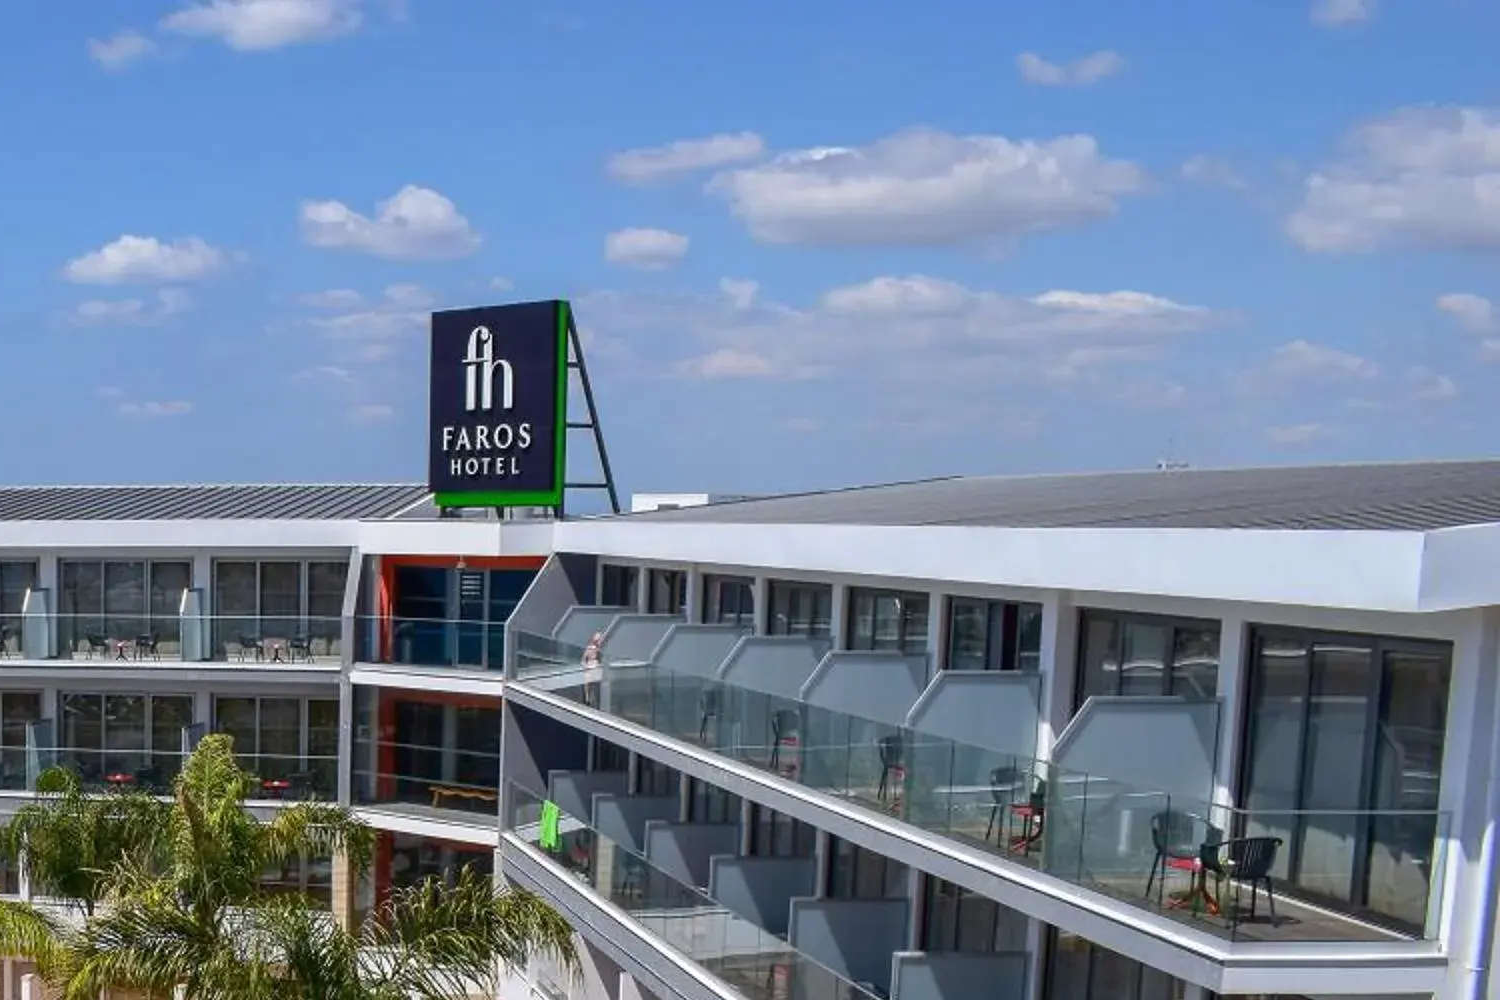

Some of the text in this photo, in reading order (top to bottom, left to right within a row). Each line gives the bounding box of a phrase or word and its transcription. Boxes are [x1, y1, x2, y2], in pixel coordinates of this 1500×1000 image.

[462, 325, 513, 411] fh
[443, 423, 531, 451] FAROS
[451, 457, 520, 475] HOTEL
